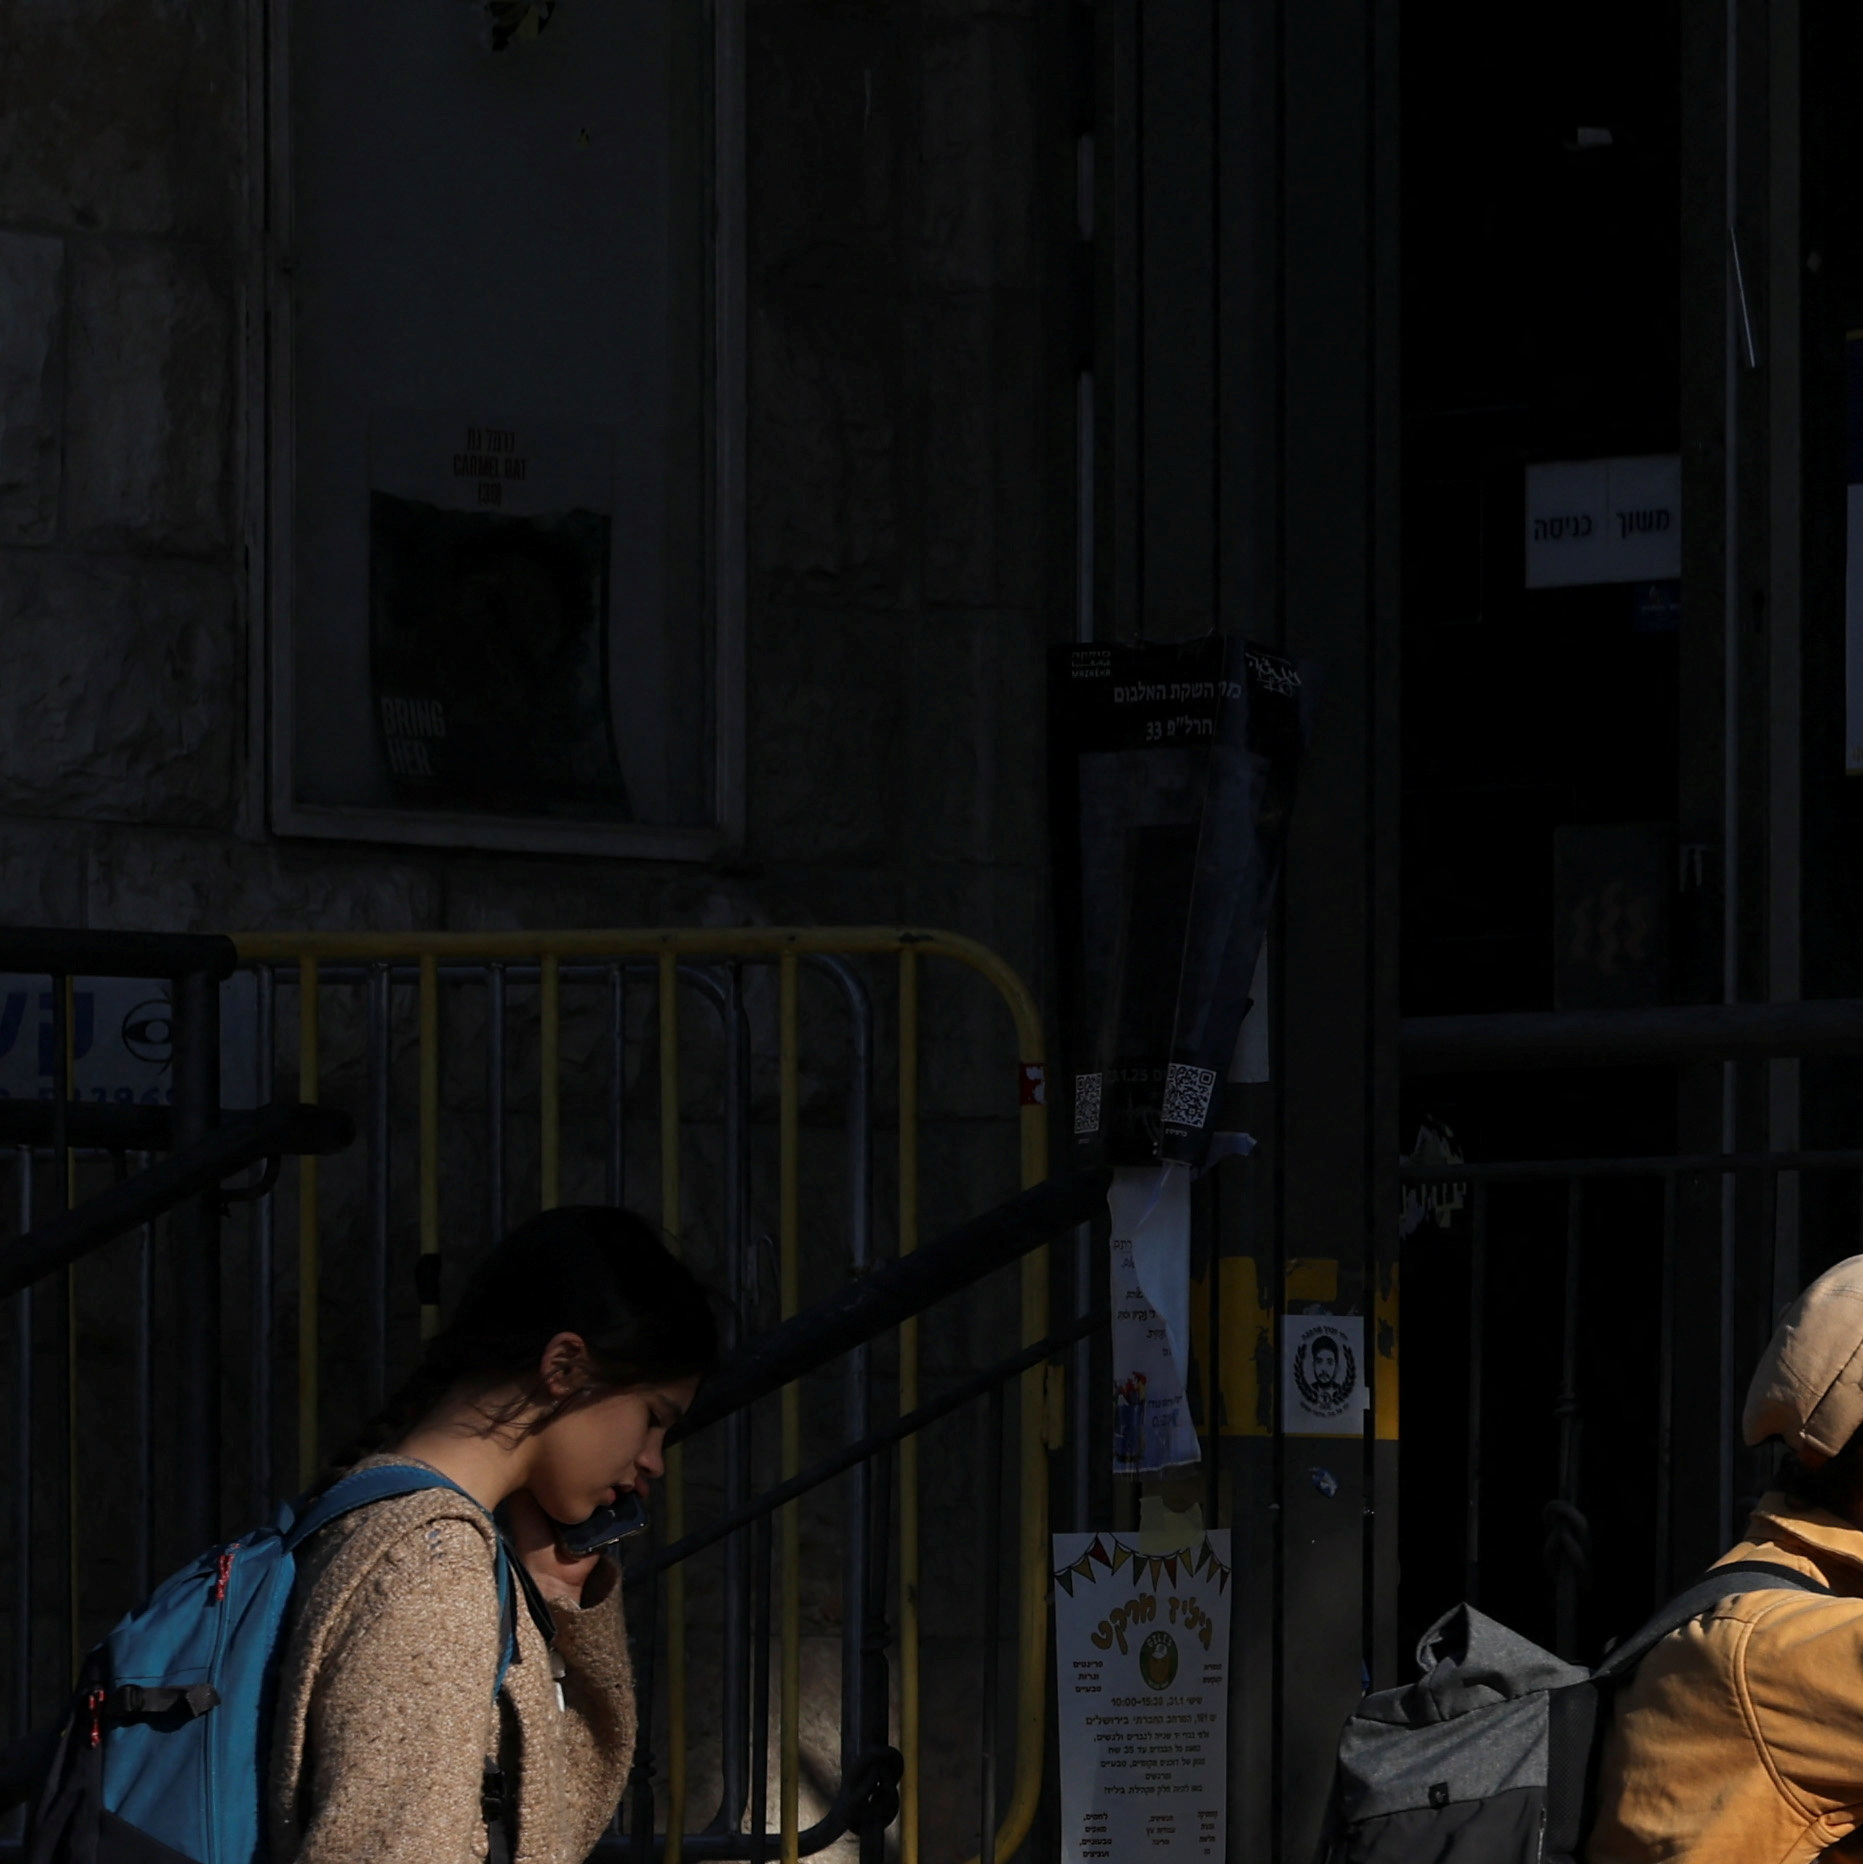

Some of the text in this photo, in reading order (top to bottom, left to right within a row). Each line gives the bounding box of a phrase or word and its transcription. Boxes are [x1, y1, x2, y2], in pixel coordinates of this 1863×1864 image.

[1534, 509, 1670, 541] משוך כניסה
[1114, 682, 1166, 703] האלבום
[1170, 682, 1214, 702] השקת
[381, 697, 446, 737] BRING
[387, 739, 433, 776] HER
[1086, 1715, 1129, 1725] בירושלים
